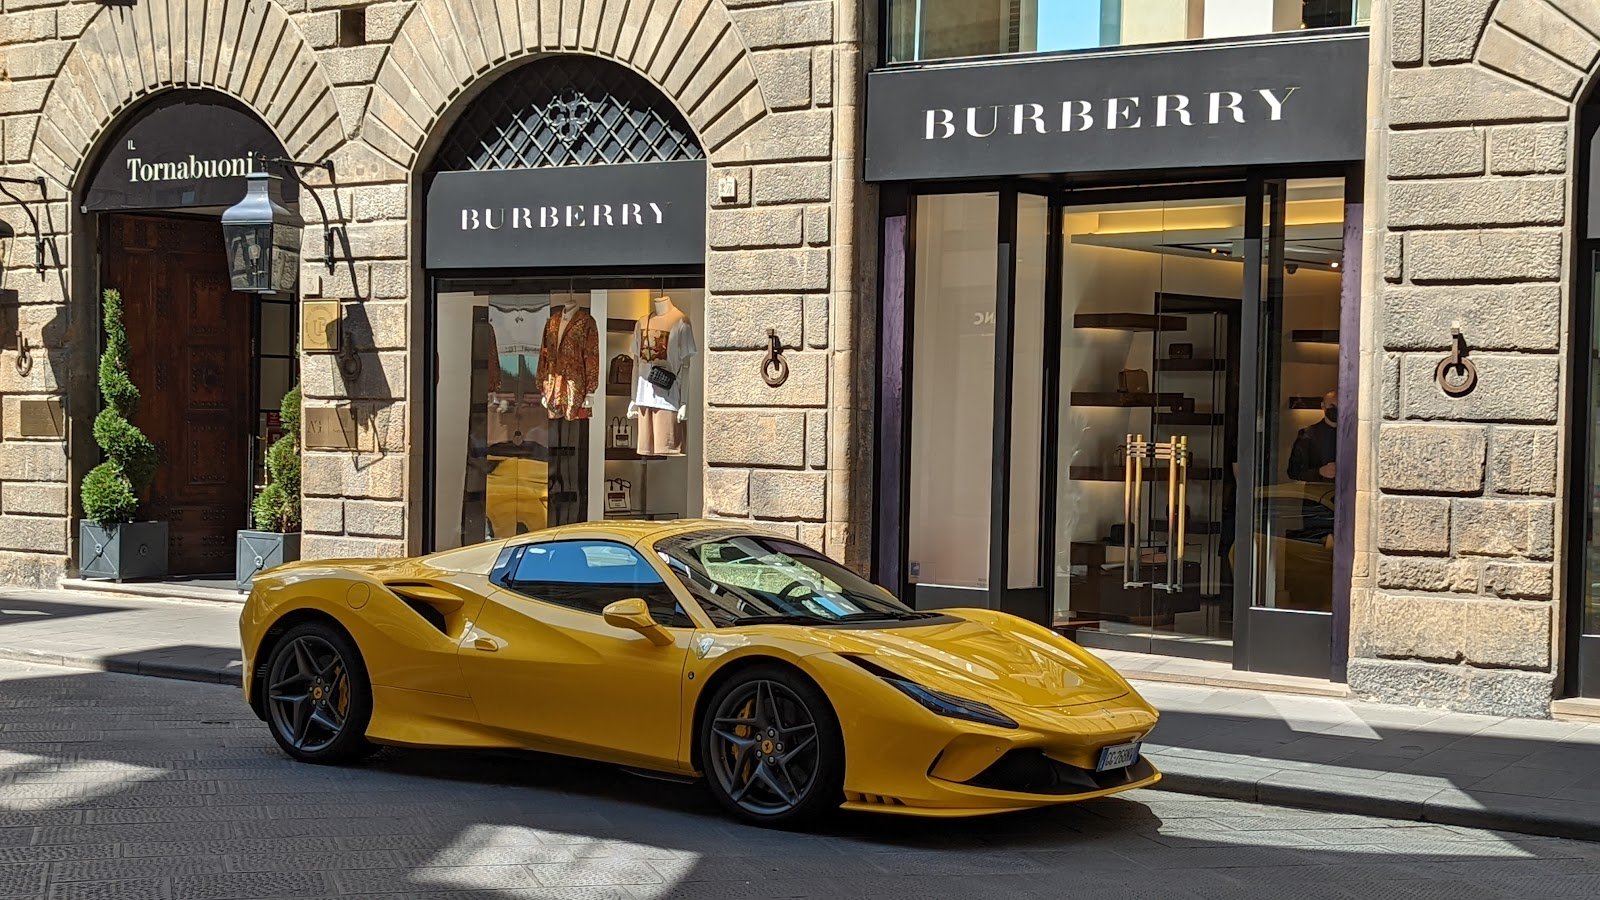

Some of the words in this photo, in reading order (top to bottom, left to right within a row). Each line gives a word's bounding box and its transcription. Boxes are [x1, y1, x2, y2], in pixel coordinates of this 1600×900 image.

[921, 87, 1300, 140] BURBERRY
[127, 139, 137, 151] IL
[126, 151, 254, 182] Tornabuoni
[460, 201, 673, 231] BURBERRY
